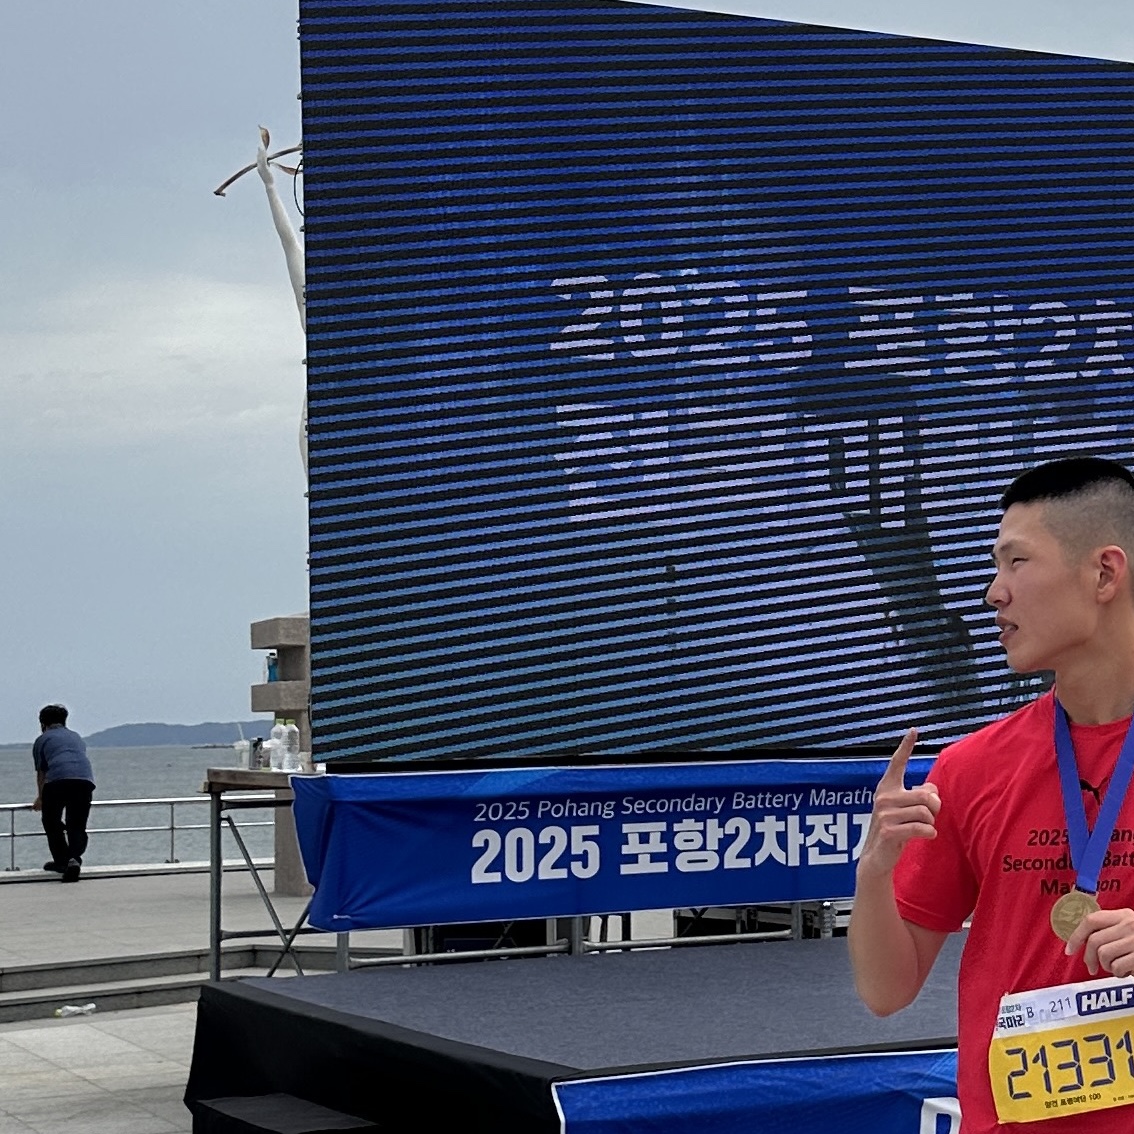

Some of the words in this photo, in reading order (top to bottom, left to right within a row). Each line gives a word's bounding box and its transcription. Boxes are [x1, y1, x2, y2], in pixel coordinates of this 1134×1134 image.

[549, 268, 813, 373] 2025
[473, 801, 530, 822] 2025
[538, 797, 615, 820] Pohang
[621, 793, 726, 816] Secondary
[732, 789, 803, 811] Battery
[809, 786, 875, 806] Marath
[471, 825, 601, 884] 2025
[1003, 852, 1073, 872] Second
[1049, 997, 1072, 1013] 211
[1081, 987, 1133, 1013] HALF
